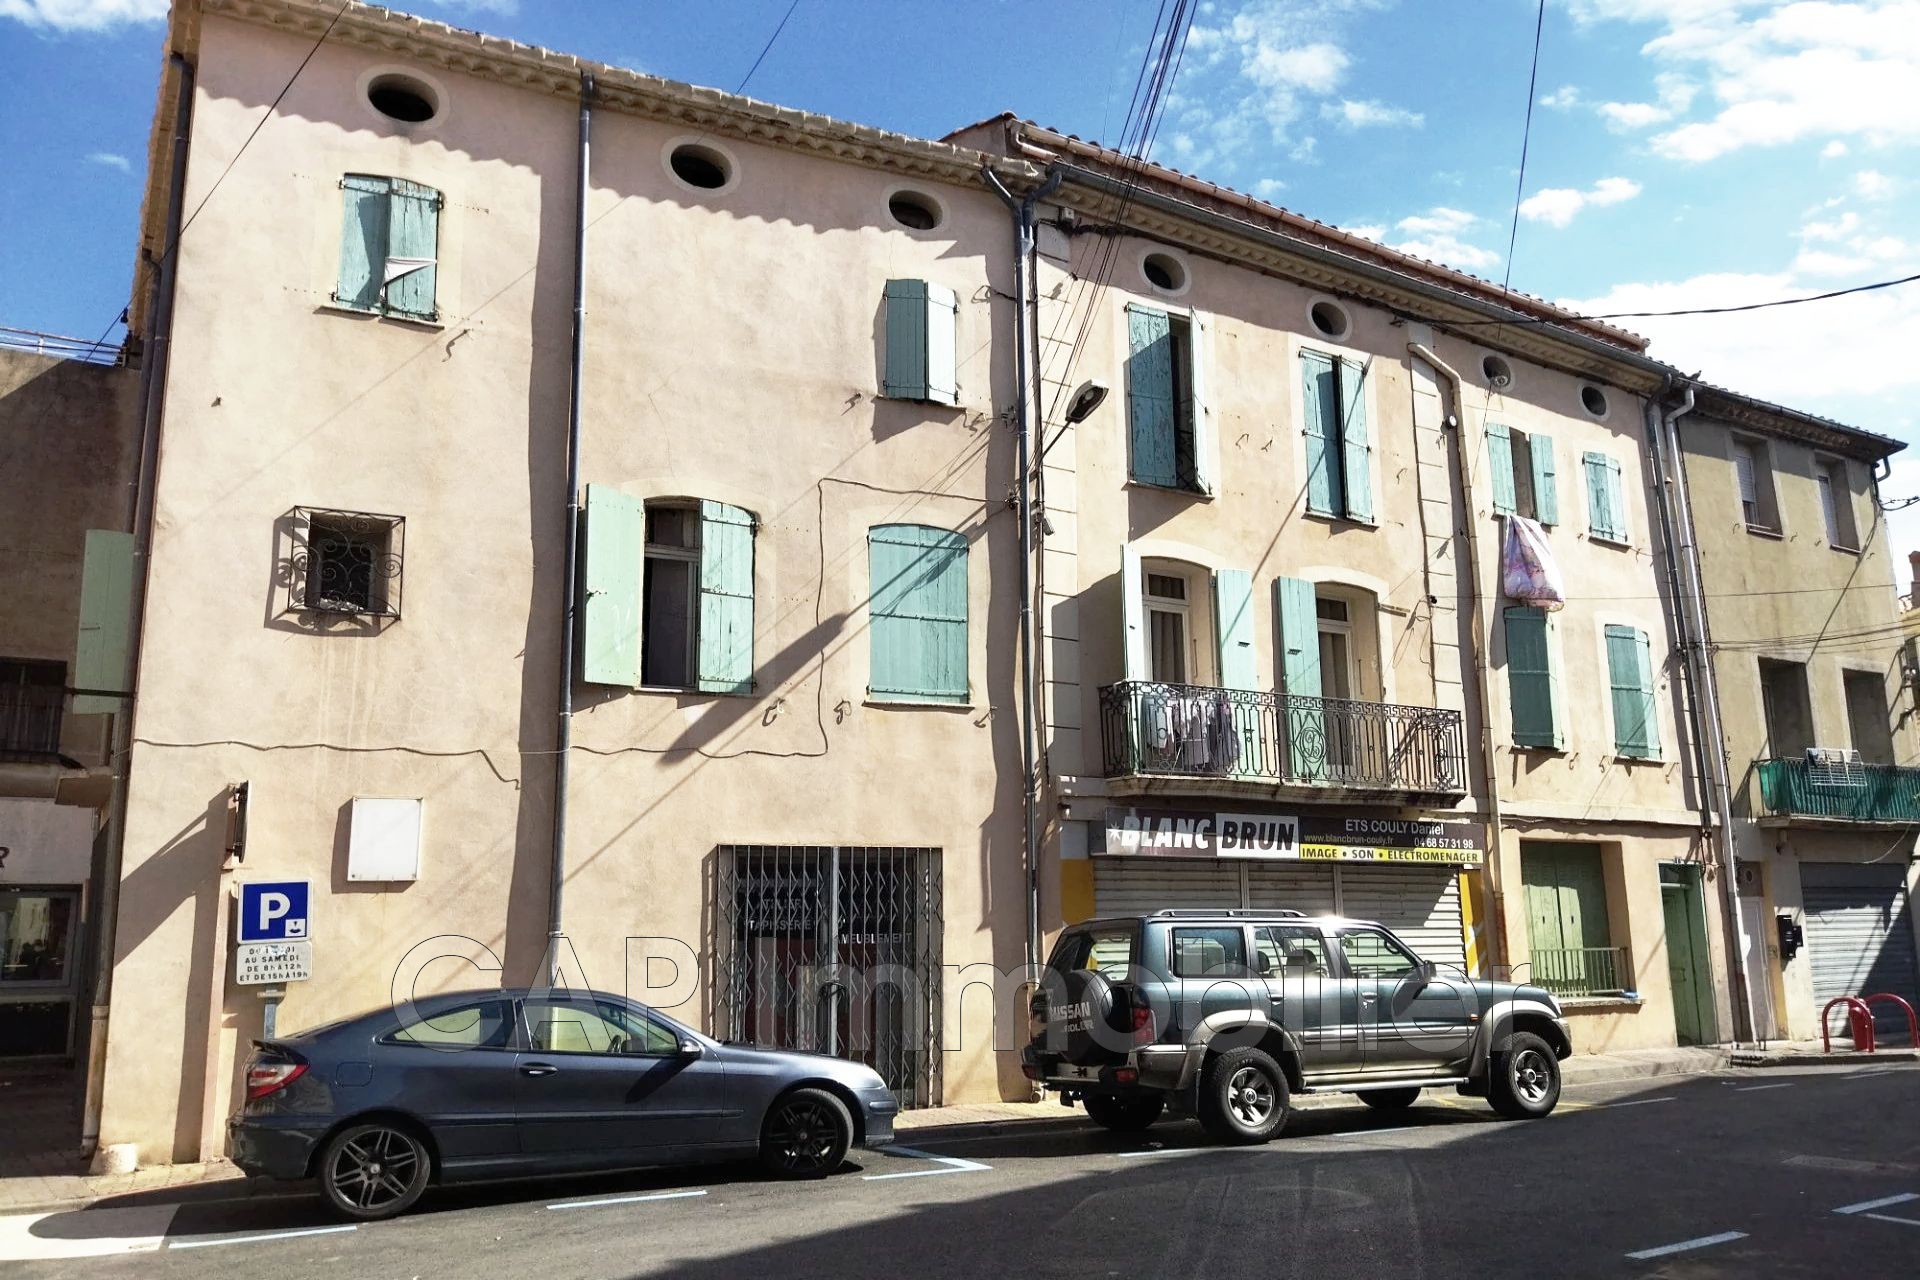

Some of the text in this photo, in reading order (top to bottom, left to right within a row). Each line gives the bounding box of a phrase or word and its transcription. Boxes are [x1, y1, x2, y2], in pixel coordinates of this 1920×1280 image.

[1121, 816, 1295, 851] BLANC BRUN
[1345, 819, 1444, 836] ETS COULY Daniel
[1426, 837, 1437, 848] 68
[1438, 838, 1449, 848] 57
[1451, 838, 1461, 849] 31
[1463, 839, 1474, 849] 98
[1302, 847, 1478, 862] IMAGE SON ELECTROMENAGER
[260, 892, 291, 930] P
[838, 932, 912, 944] MEUBLEMENT
[261, 955, 299, 963] SAMEDI
[247, 965, 259, 973] DE
[239, 974, 251, 982] ET
[1050, 1002, 1091, 1021] NISSAN
